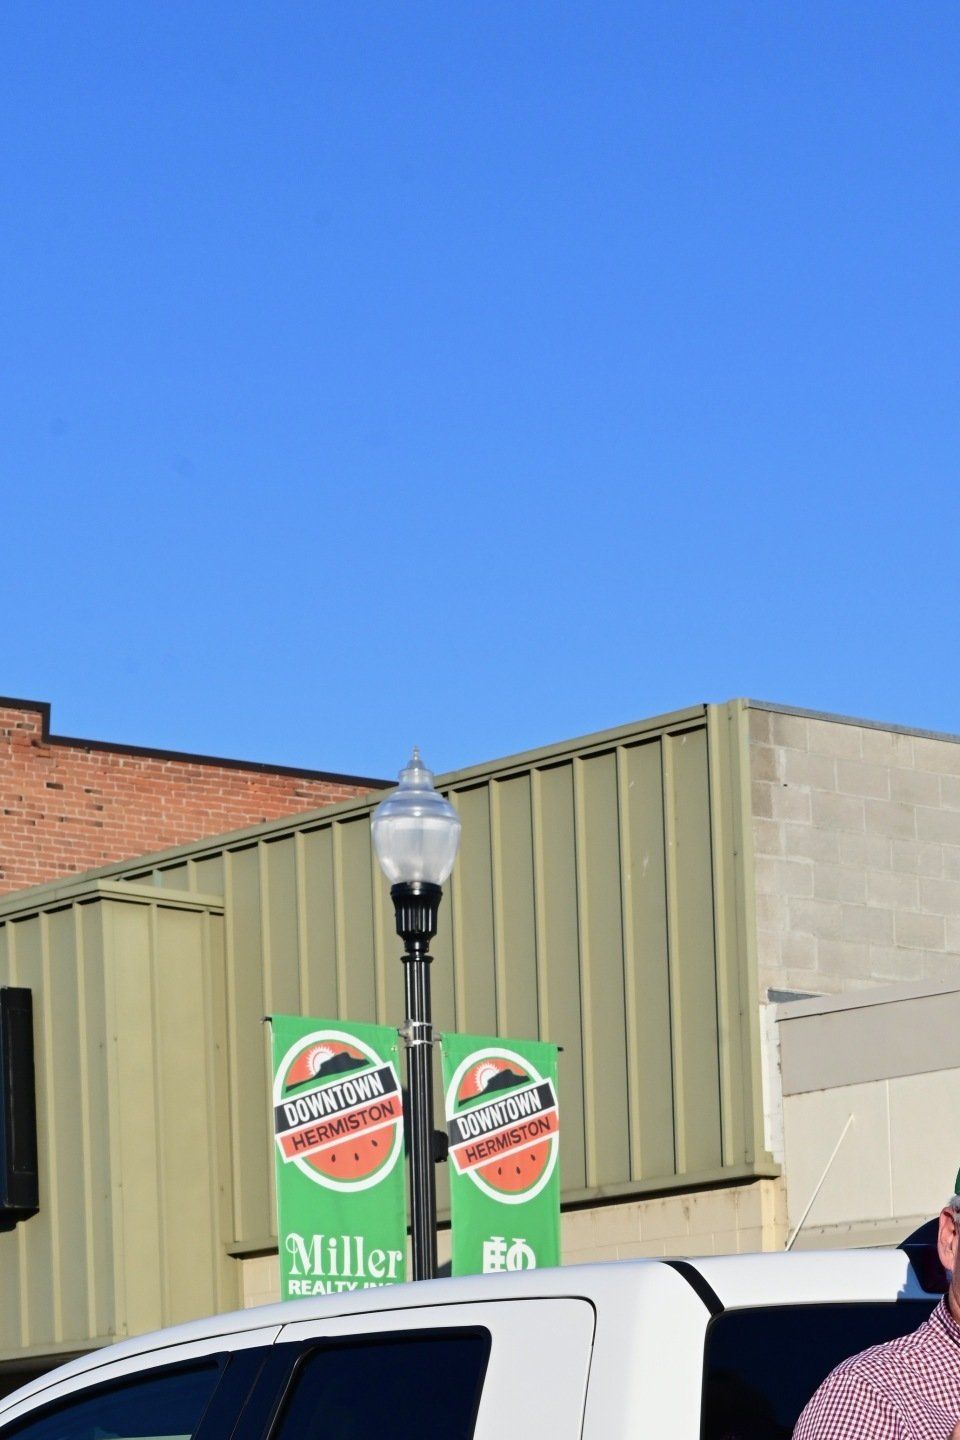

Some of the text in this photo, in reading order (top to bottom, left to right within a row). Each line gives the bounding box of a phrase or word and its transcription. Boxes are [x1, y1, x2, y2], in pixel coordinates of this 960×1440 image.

[283, 1072, 385, 1127] DOWNTOWN
[457, 1088, 543, 1140] DOWNTOWN
[291, 1101, 395, 1151] HERMISTON
[465, 1116, 551, 1164] HERMISTON
[285, 1232, 403, 1279] Miller
[288, 1279, 359, 1296] REALTY
